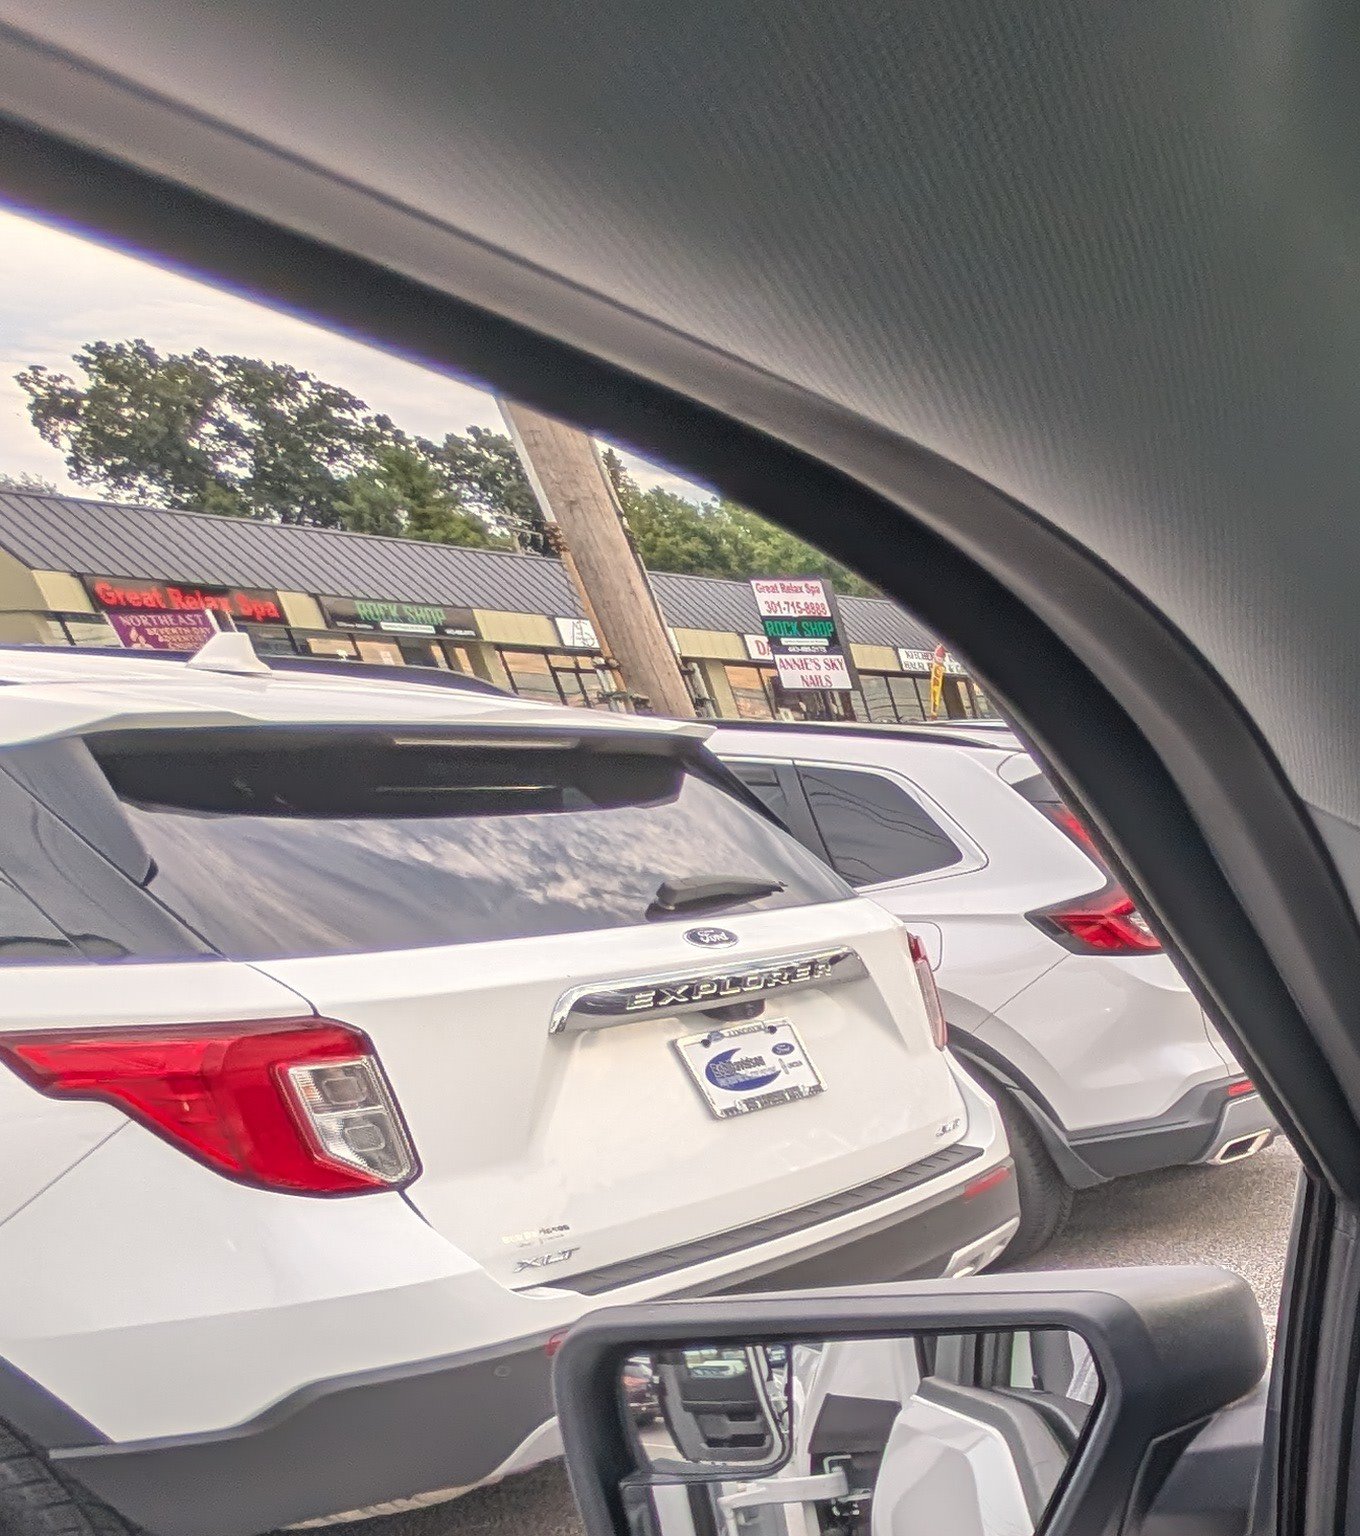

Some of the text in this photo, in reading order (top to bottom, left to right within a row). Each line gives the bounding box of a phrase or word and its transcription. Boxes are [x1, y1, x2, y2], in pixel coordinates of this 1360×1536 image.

[755, 583, 821, 596] Great Relax Spa
[94, 581, 166, 609] Great
[235, 593, 279, 622] Spa
[119, 614, 205, 627] NORTHEAST
[355, 601, 447, 626] ROCK SHOP
[765, 621, 834, 636] ROCK SHOP
[780, 658, 845, 671] ANNIE'S SKY
[800, 675, 833, 687] NAILS
[626, 960, 833, 1010] EXPLORER
[513, 1247, 580, 1273] XLT
